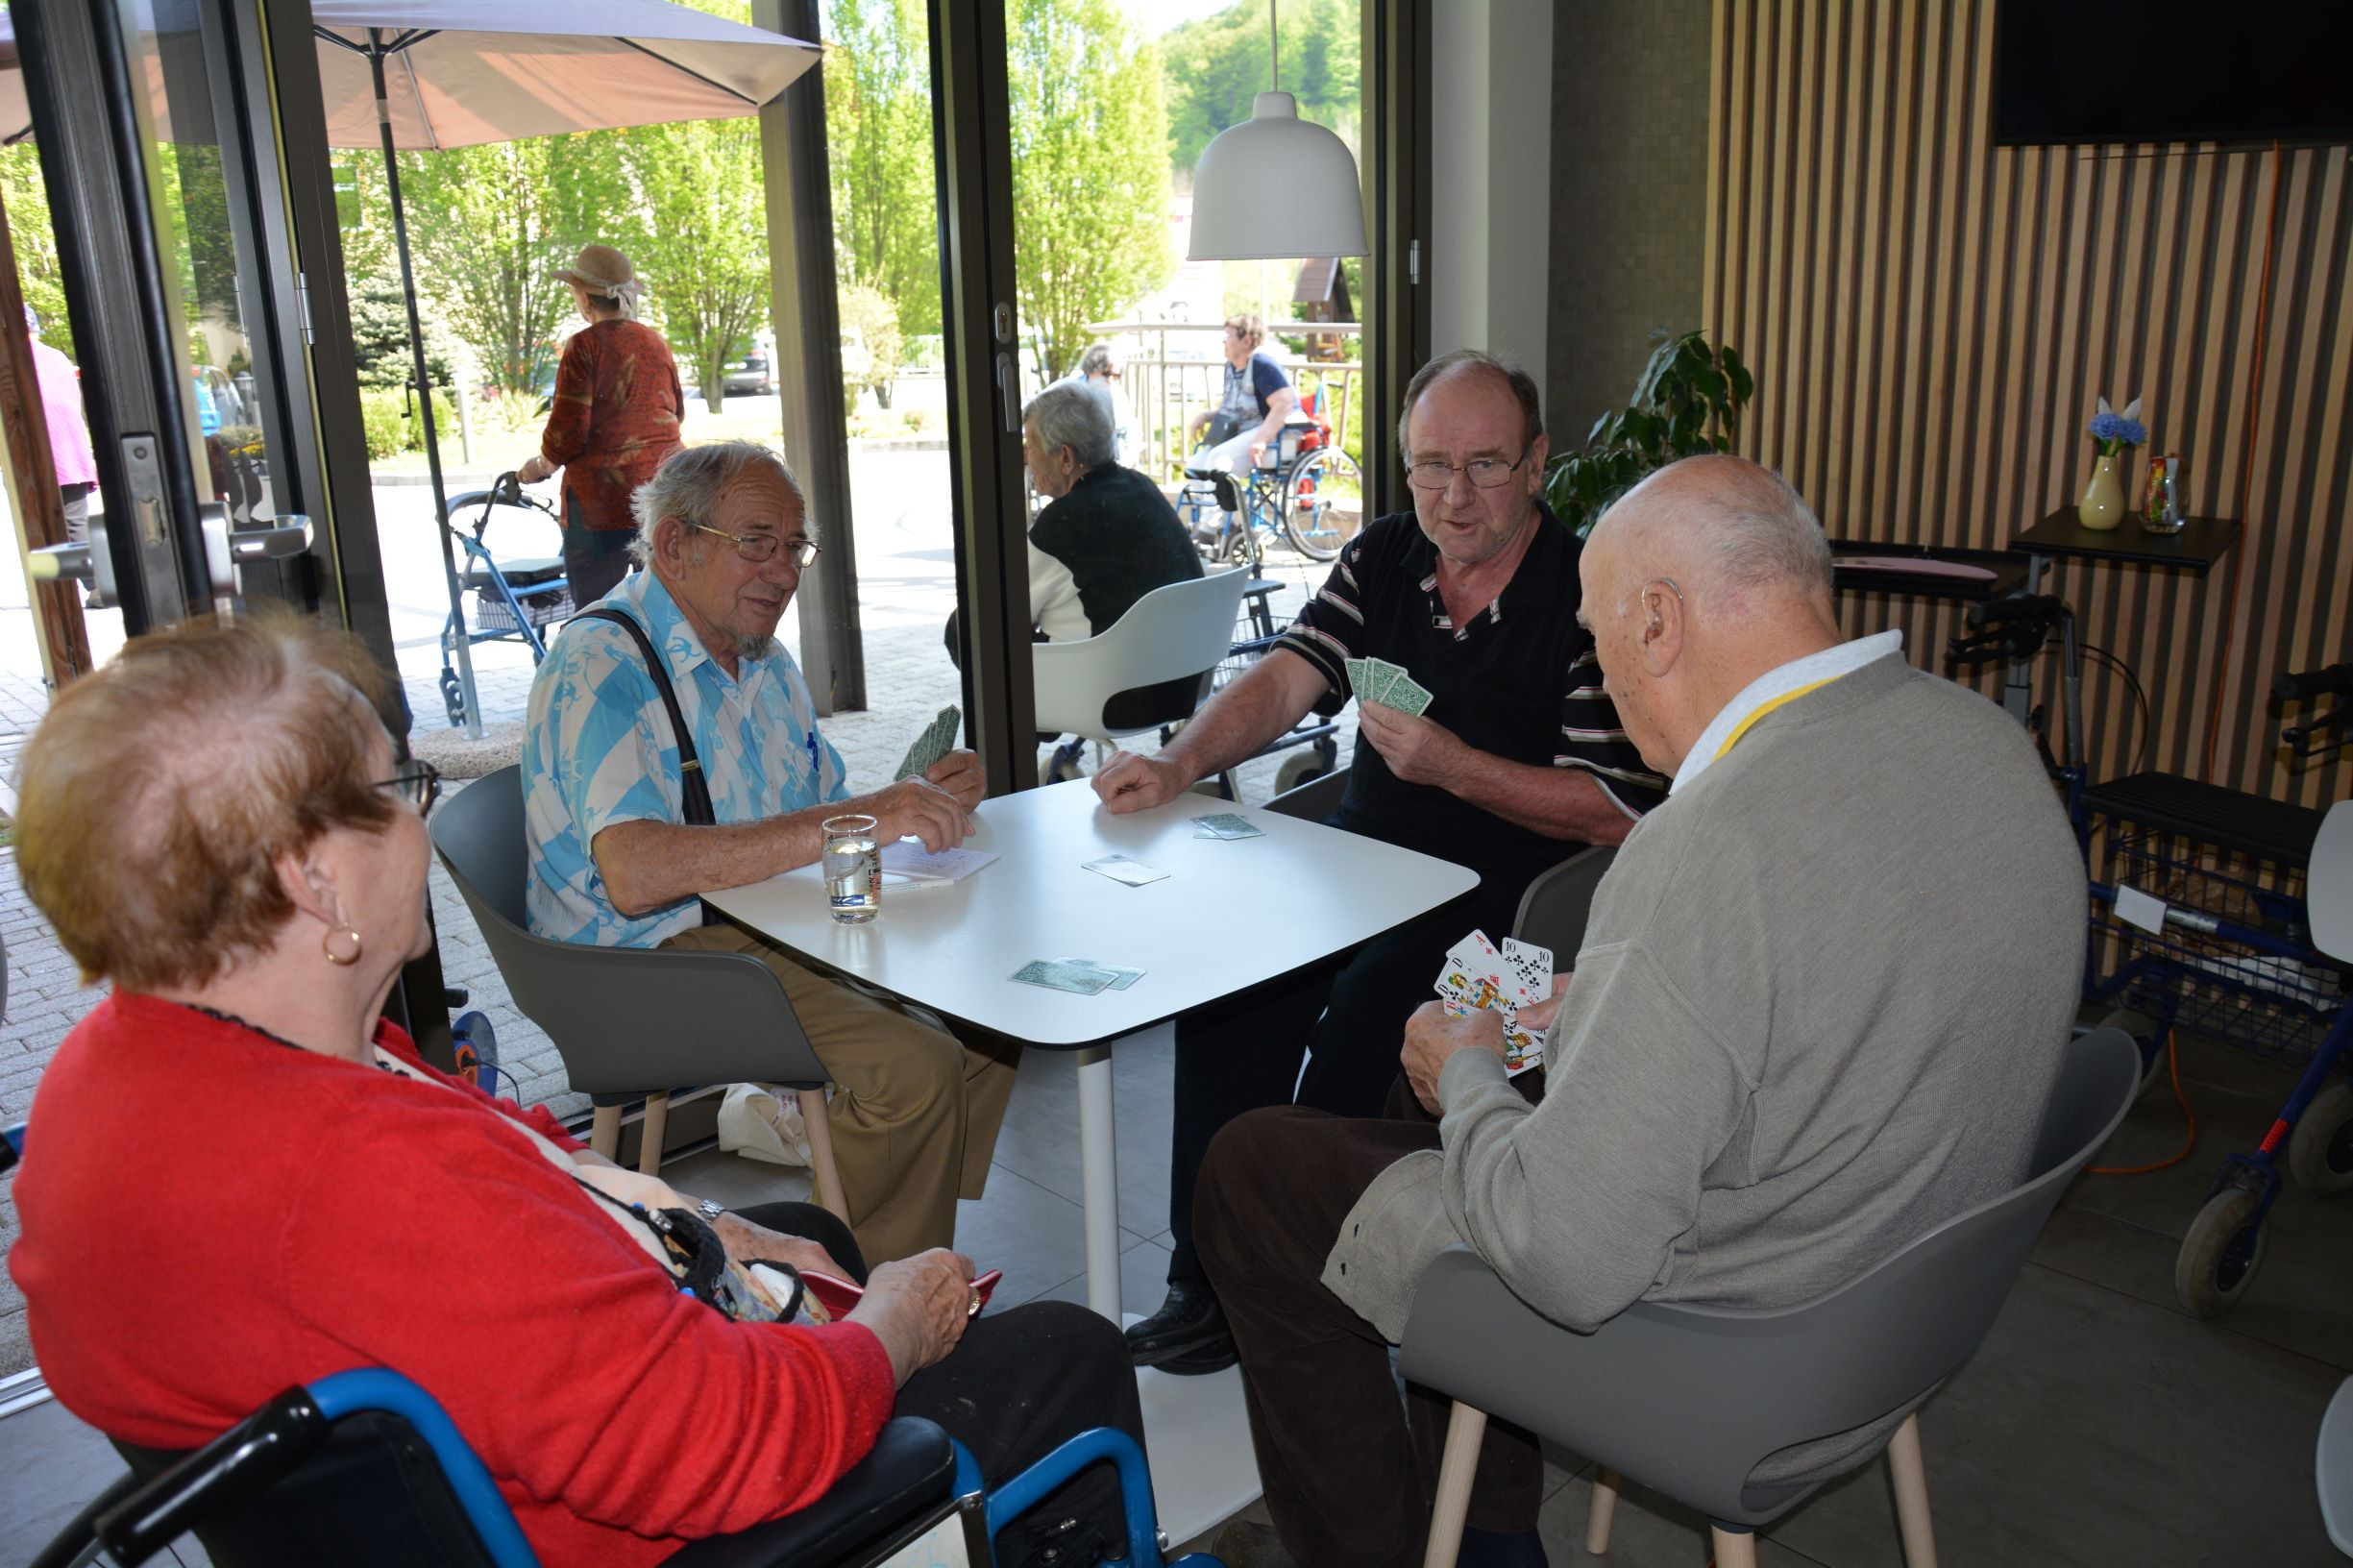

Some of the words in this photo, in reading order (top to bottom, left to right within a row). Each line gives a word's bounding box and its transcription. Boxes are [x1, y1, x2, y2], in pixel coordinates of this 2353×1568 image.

[1476, 934, 1486, 945] A
[1506, 941, 1516, 953] 10
[1538, 950, 1550, 963] 10
[1452, 957, 1463, 968] D
[1437, 984, 1449, 995] D
[1446, 1000, 1457, 1011] B
